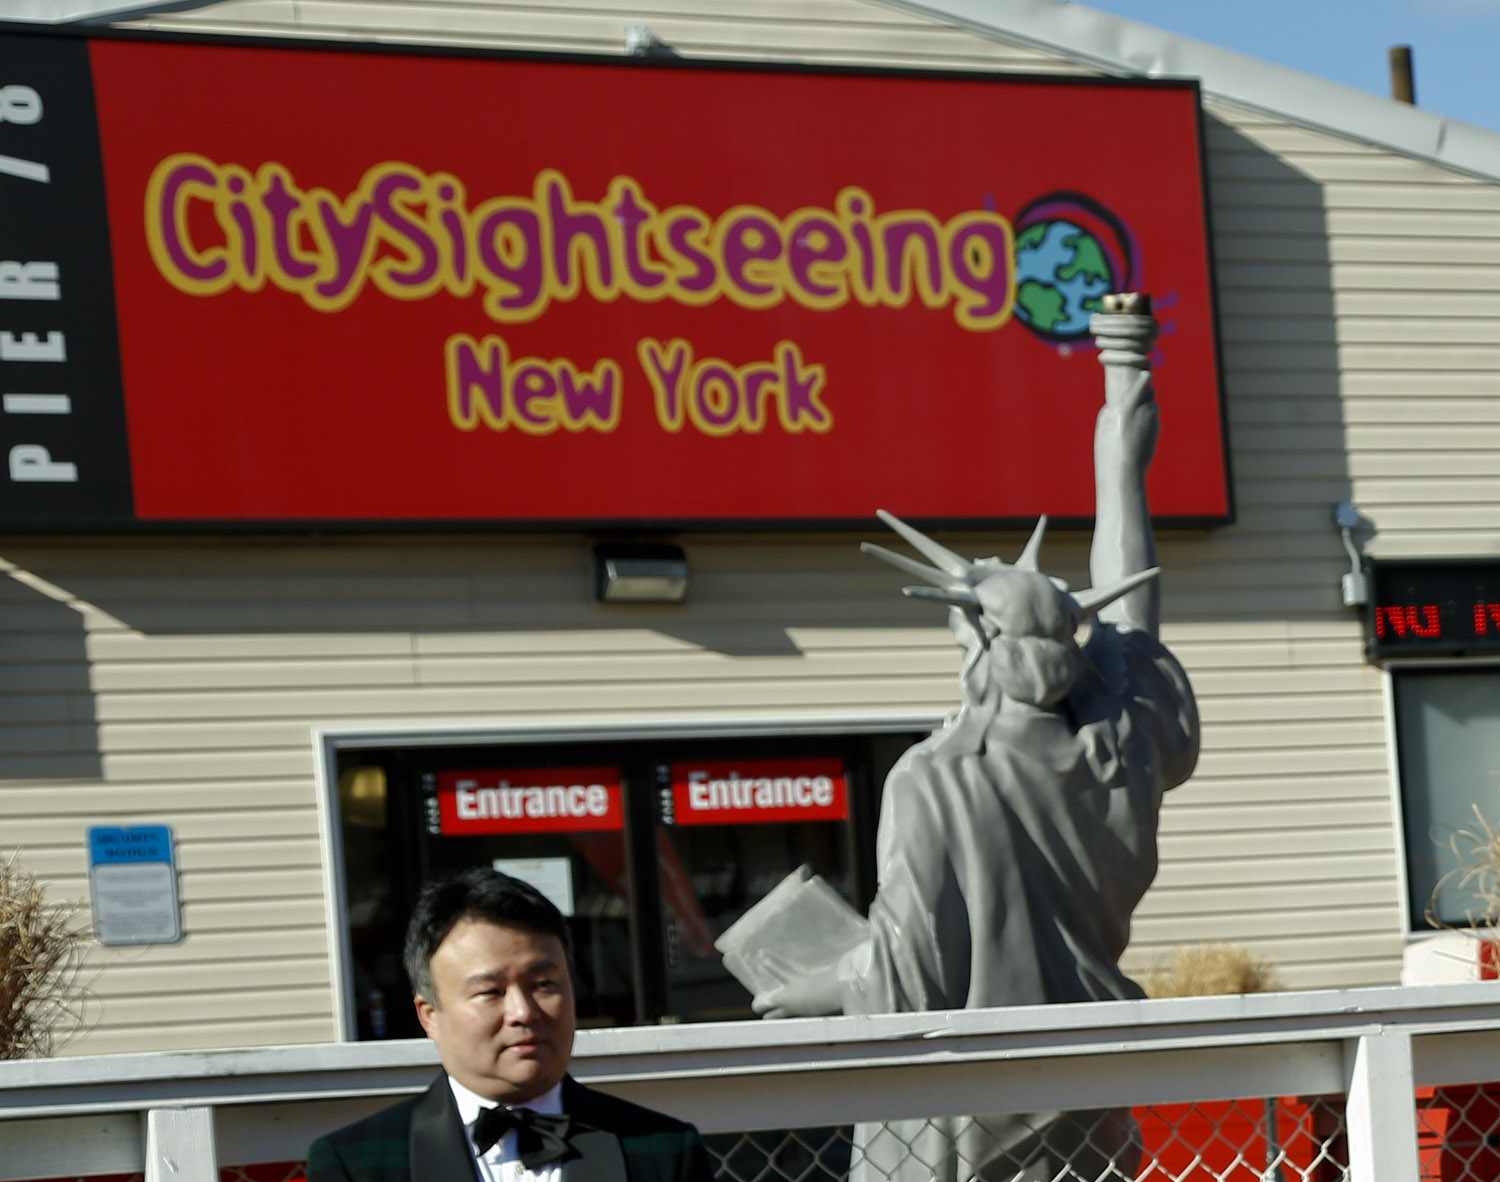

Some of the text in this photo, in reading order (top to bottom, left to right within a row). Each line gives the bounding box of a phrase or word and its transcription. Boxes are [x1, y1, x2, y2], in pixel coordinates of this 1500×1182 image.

[144, 153, 1017, 333] CitySightseeing
[0, 261, 78, 482] PIER
[444, 334, 832, 436] New York
[455, 779, 609, 820] Entrance
[688, 771, 834, 810] Entrance
